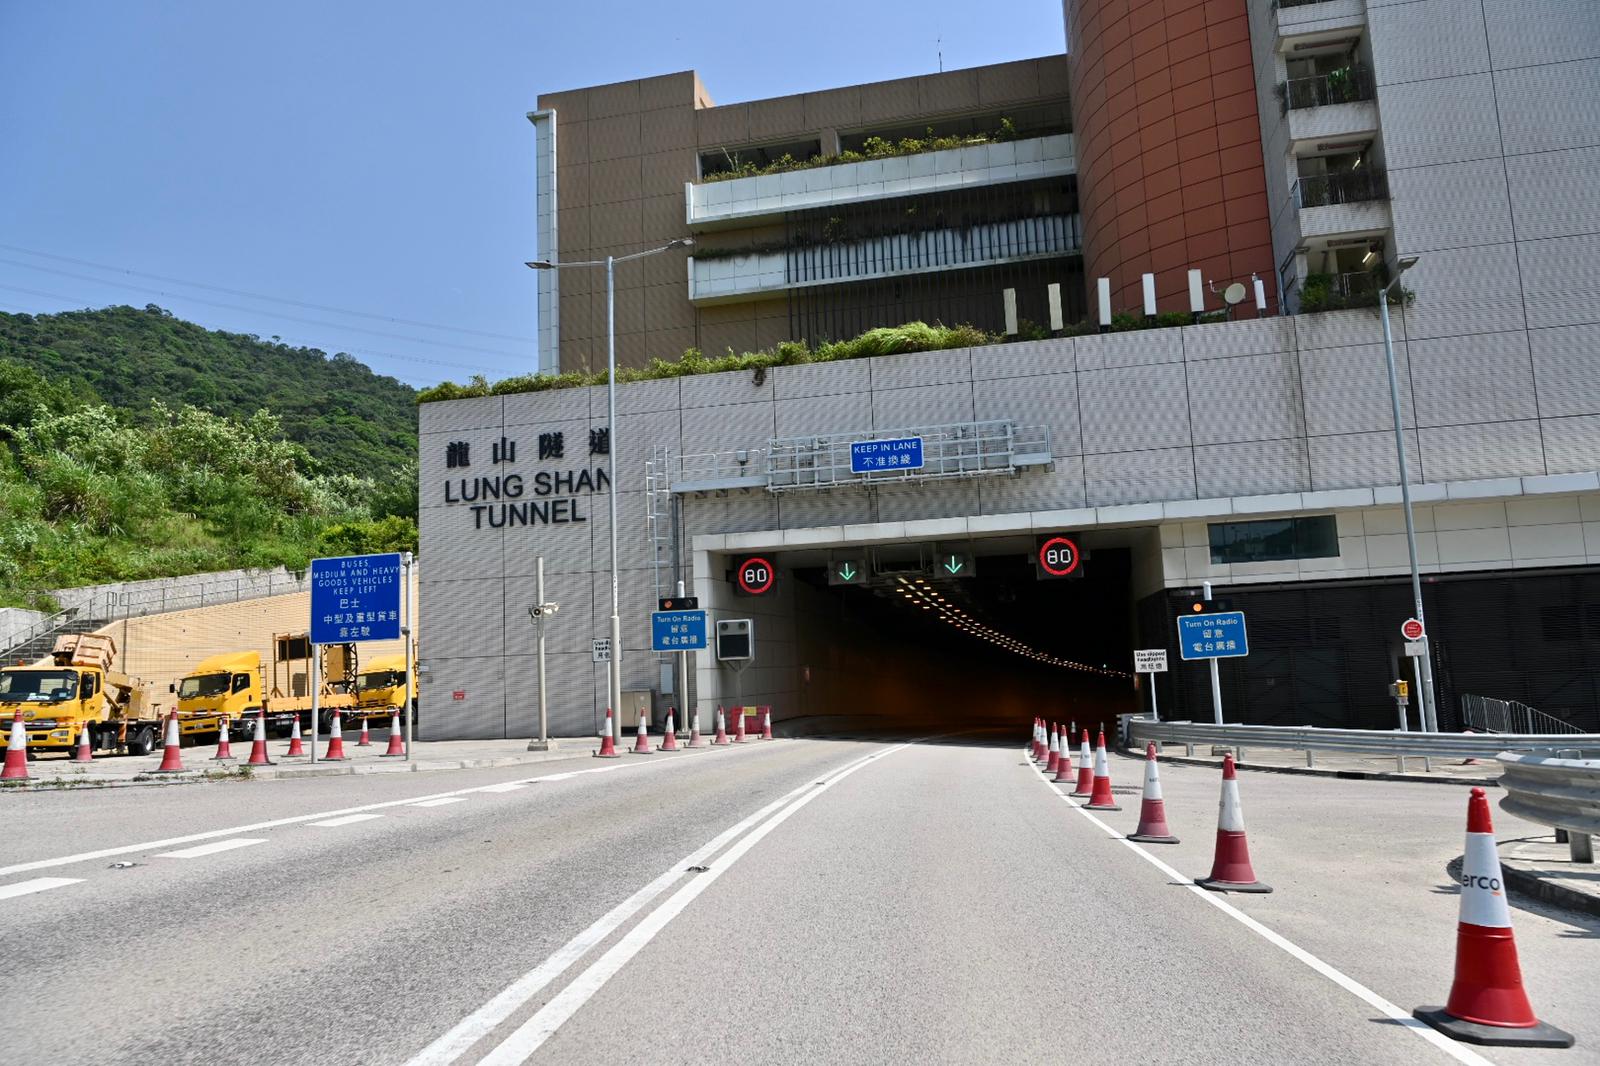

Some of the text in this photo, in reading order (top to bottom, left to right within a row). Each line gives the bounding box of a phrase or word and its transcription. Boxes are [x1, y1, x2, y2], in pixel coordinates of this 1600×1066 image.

[446, 427, 610, 469] 龍山隧道
[854, 441, 918, 454] KEEP IN LANE
[444, 467, 610, 503] LUNG SHAN
[470, 499, 587, 529] TUNNEL
[1047, 549, 1071, 564] 80
[313, 566, 399, 580] MEDIUM AND HEAVY
[745, 568, 767, 583] 80
[318, 575, 393, 588] GOODS VEHICLES
[333, 585, 377, 596] KEEP LEFT
[323, 610, 397, 625] 中型及重型貨車
[1203, 619, 1215, 627] On
[1216, 616, 1238, 626] Radio
